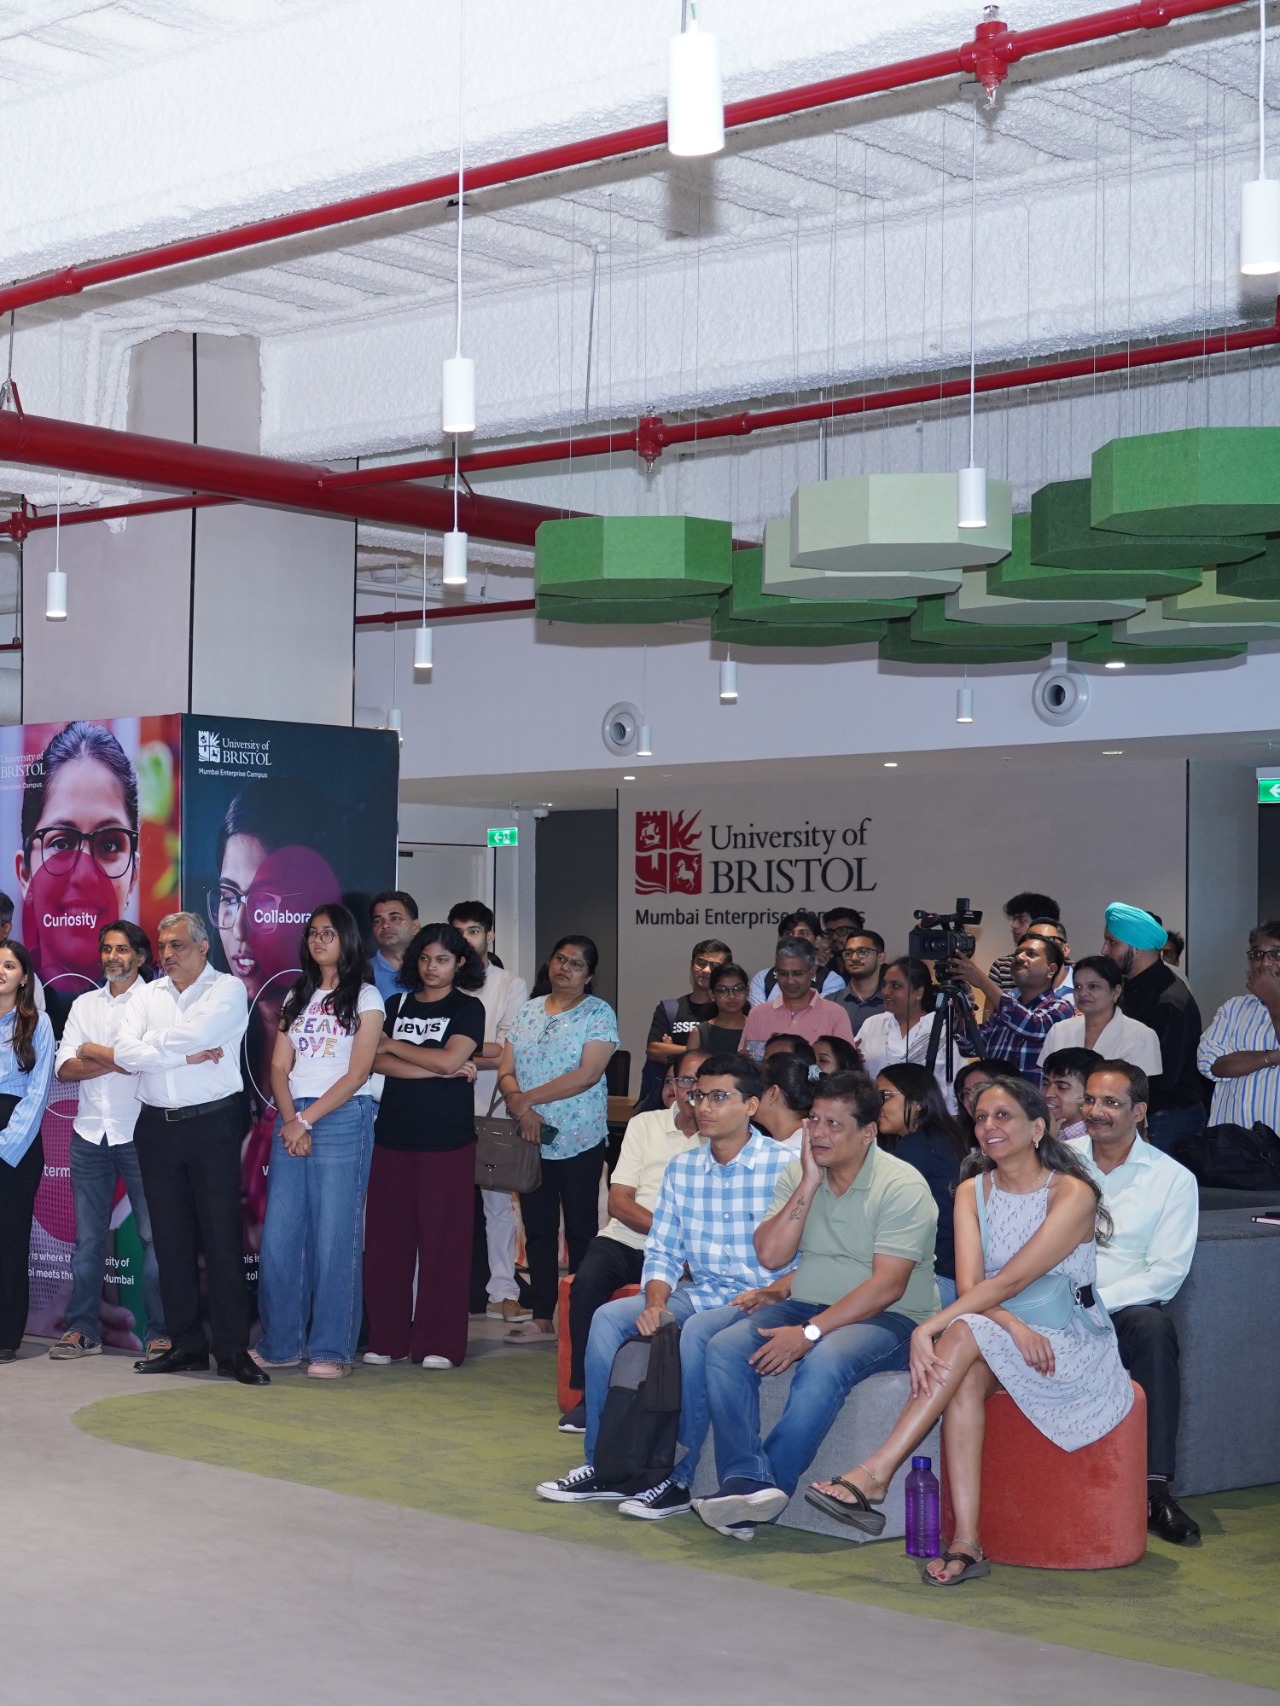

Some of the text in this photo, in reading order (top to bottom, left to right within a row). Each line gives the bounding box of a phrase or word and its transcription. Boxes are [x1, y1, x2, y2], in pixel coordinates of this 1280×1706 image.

[222, 738, 270, 752] University of
[0, 750, 45, 764] University of
[223, 750, 272, 766] BRISTOL
[1, 763, 47, 778] BRISTOL
[199, 767, 268, 779] Mumbai Enterprise Campus
[22, 782, 43, 790] Campus
[709, 817, 873, 855] University of
[709, 856, 878, 895] BRISTOL
[43, 912, 97, 929] Curiosity
[635, 907, 699, 926] Mumbai
[298, 1036, 337, 1057] OVE
[43, 1163, 70, 1177] term
[31, 1251, 39, 1260] is
[40, 1252, 63, 1262] where
[105, 1256, 119, 1268] sity
[120, 1257, 130, 1267] of
[36, 1269, 60, 1278] meets
